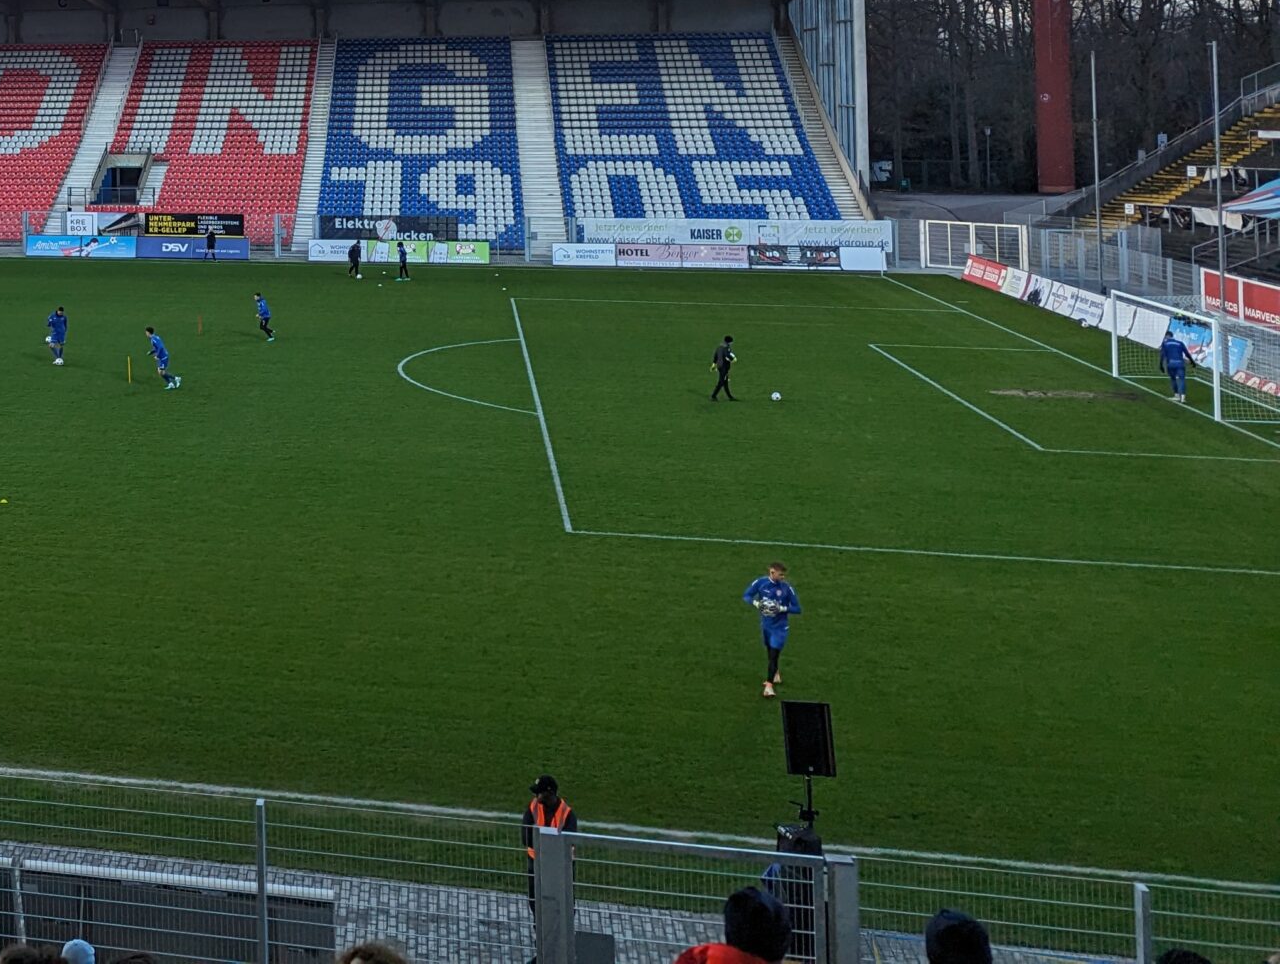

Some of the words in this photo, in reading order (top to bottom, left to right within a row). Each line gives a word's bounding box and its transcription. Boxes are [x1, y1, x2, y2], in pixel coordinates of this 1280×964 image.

[334, 218, 384, 229] Elektro
[596, 223, 616, 232] Jetzt
[690, 228, 722, 240] KAISER
[805, 225, 827, 234] Jetzt
[831, 225, 882, 233] bewerben!
[389, 230, 433, 241] Hucken
[33, 240, 59, 250] Amira
[162, 243, 188, 252] DSV
[618, 249, 650, 257] HOTEL
[1206, 295, 1238, 312] MARECS
[1245, 307, 1280, 324] MARVECS
